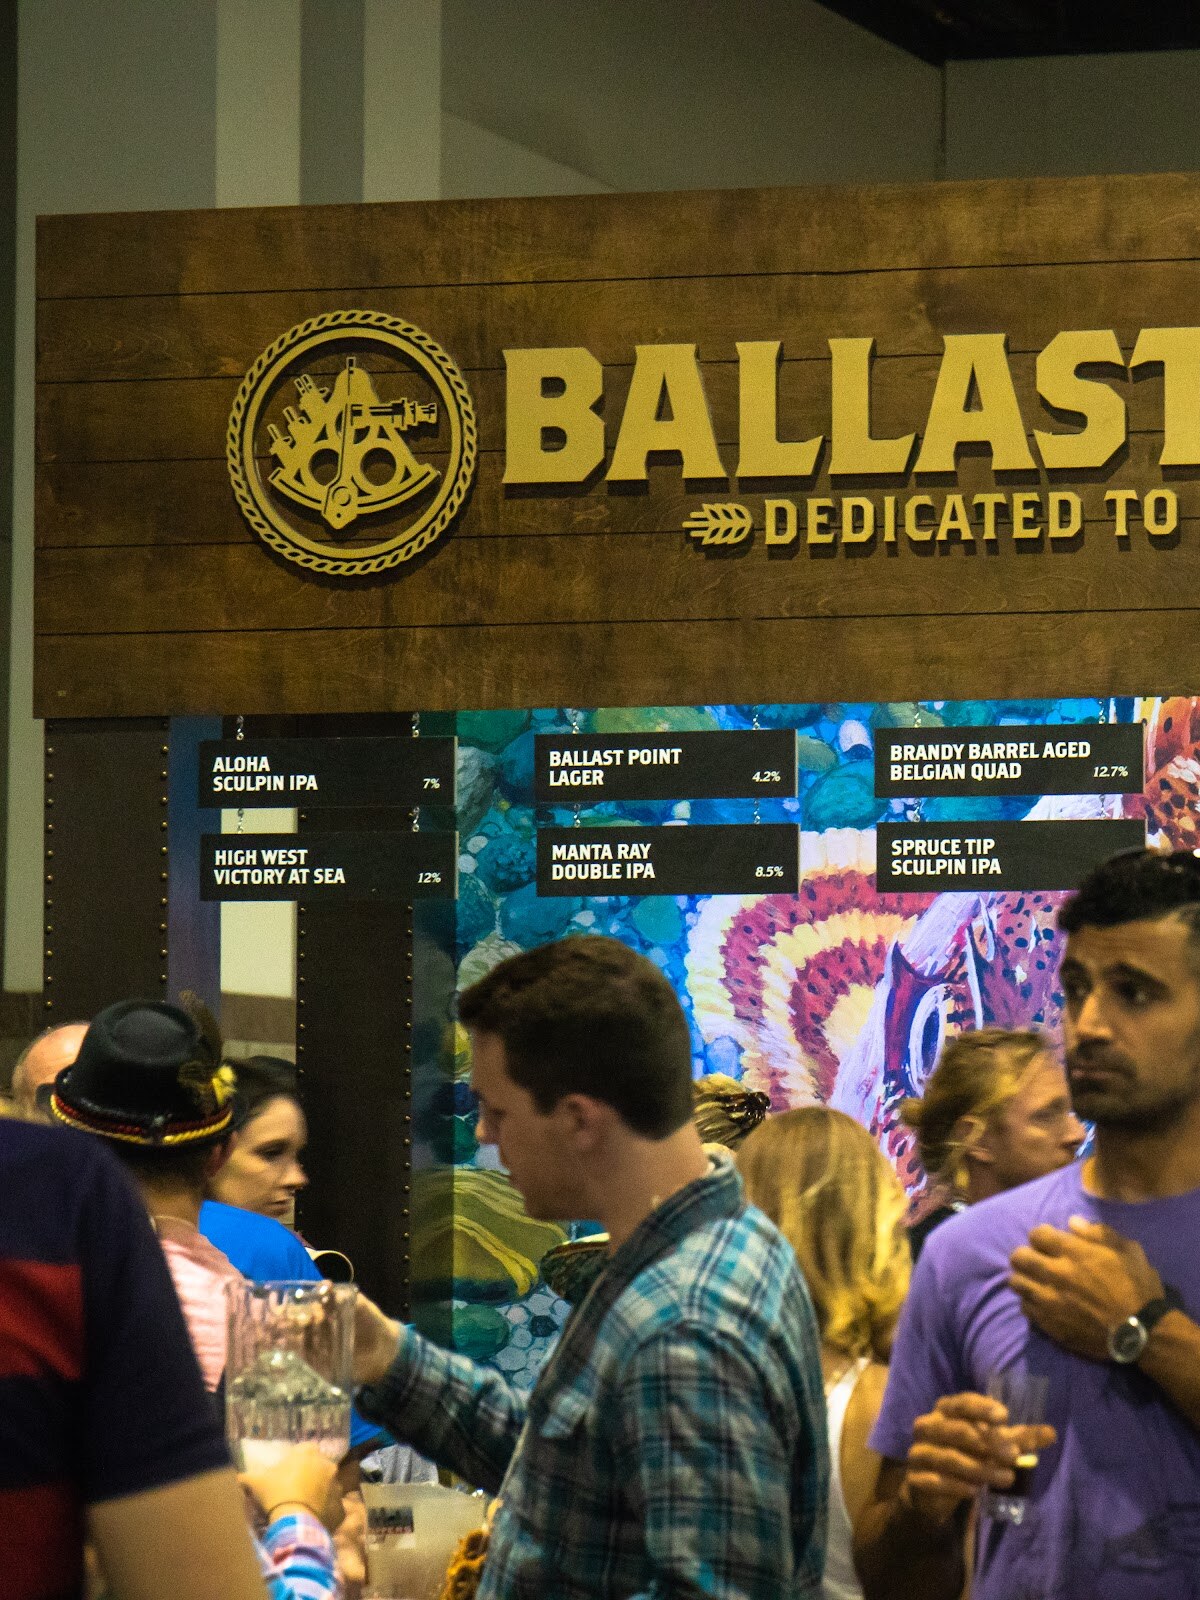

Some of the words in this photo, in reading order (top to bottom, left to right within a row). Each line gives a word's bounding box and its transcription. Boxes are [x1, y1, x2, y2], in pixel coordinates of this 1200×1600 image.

[764, 491, 1083, 545] DEDICATED
[1103, 488, 1177, 537] TO
[549, 750, 624, 767] BALLAST
[628, 748, 682, 765] POINT
[890, 744, 965, 761] BRANDY
[968, 742, 1039, 760] BARREL
[1042, 741, 1091, 759] AGED
[212, 756, 270, 773] ALOHA
[890, 764, 965, 781] BELGIAN
[971, 762, 1022, 781] QUAD
[1093, 765, 1129, 778] 12.7%
[213, 775, 285, 792] SCULPIN
[289, 775, 318, 791] IPA
[423, 778, 440, 789] 7%
[549, 770, 604, 787] LAGER
[752, 771, 781, 782] 4.2%
[552, 844, 613, 861] MANTA
[617, 843, 651, 860] RAY
[891, 839, 962, 856] SPRUCE
[964, 838, 996, 855] TIP
[214, 849, 257, 866] HIGH
[261, 849, 308, 865] WEST
[552, 863, 622, 881] DOUBLE
[626, 862, 656, 879] IPA
[755, 866, 784, 877] 8.5%
[891, 859, 966, 876] SCULPIN
[971, 858, 1002, 875] IPA
[214, 869, 284, 885] VICTORY
[288, 869, 310, 884] AT
[313, 868, 346, 884] SEA
[418, 872, 442, 884] 12%
